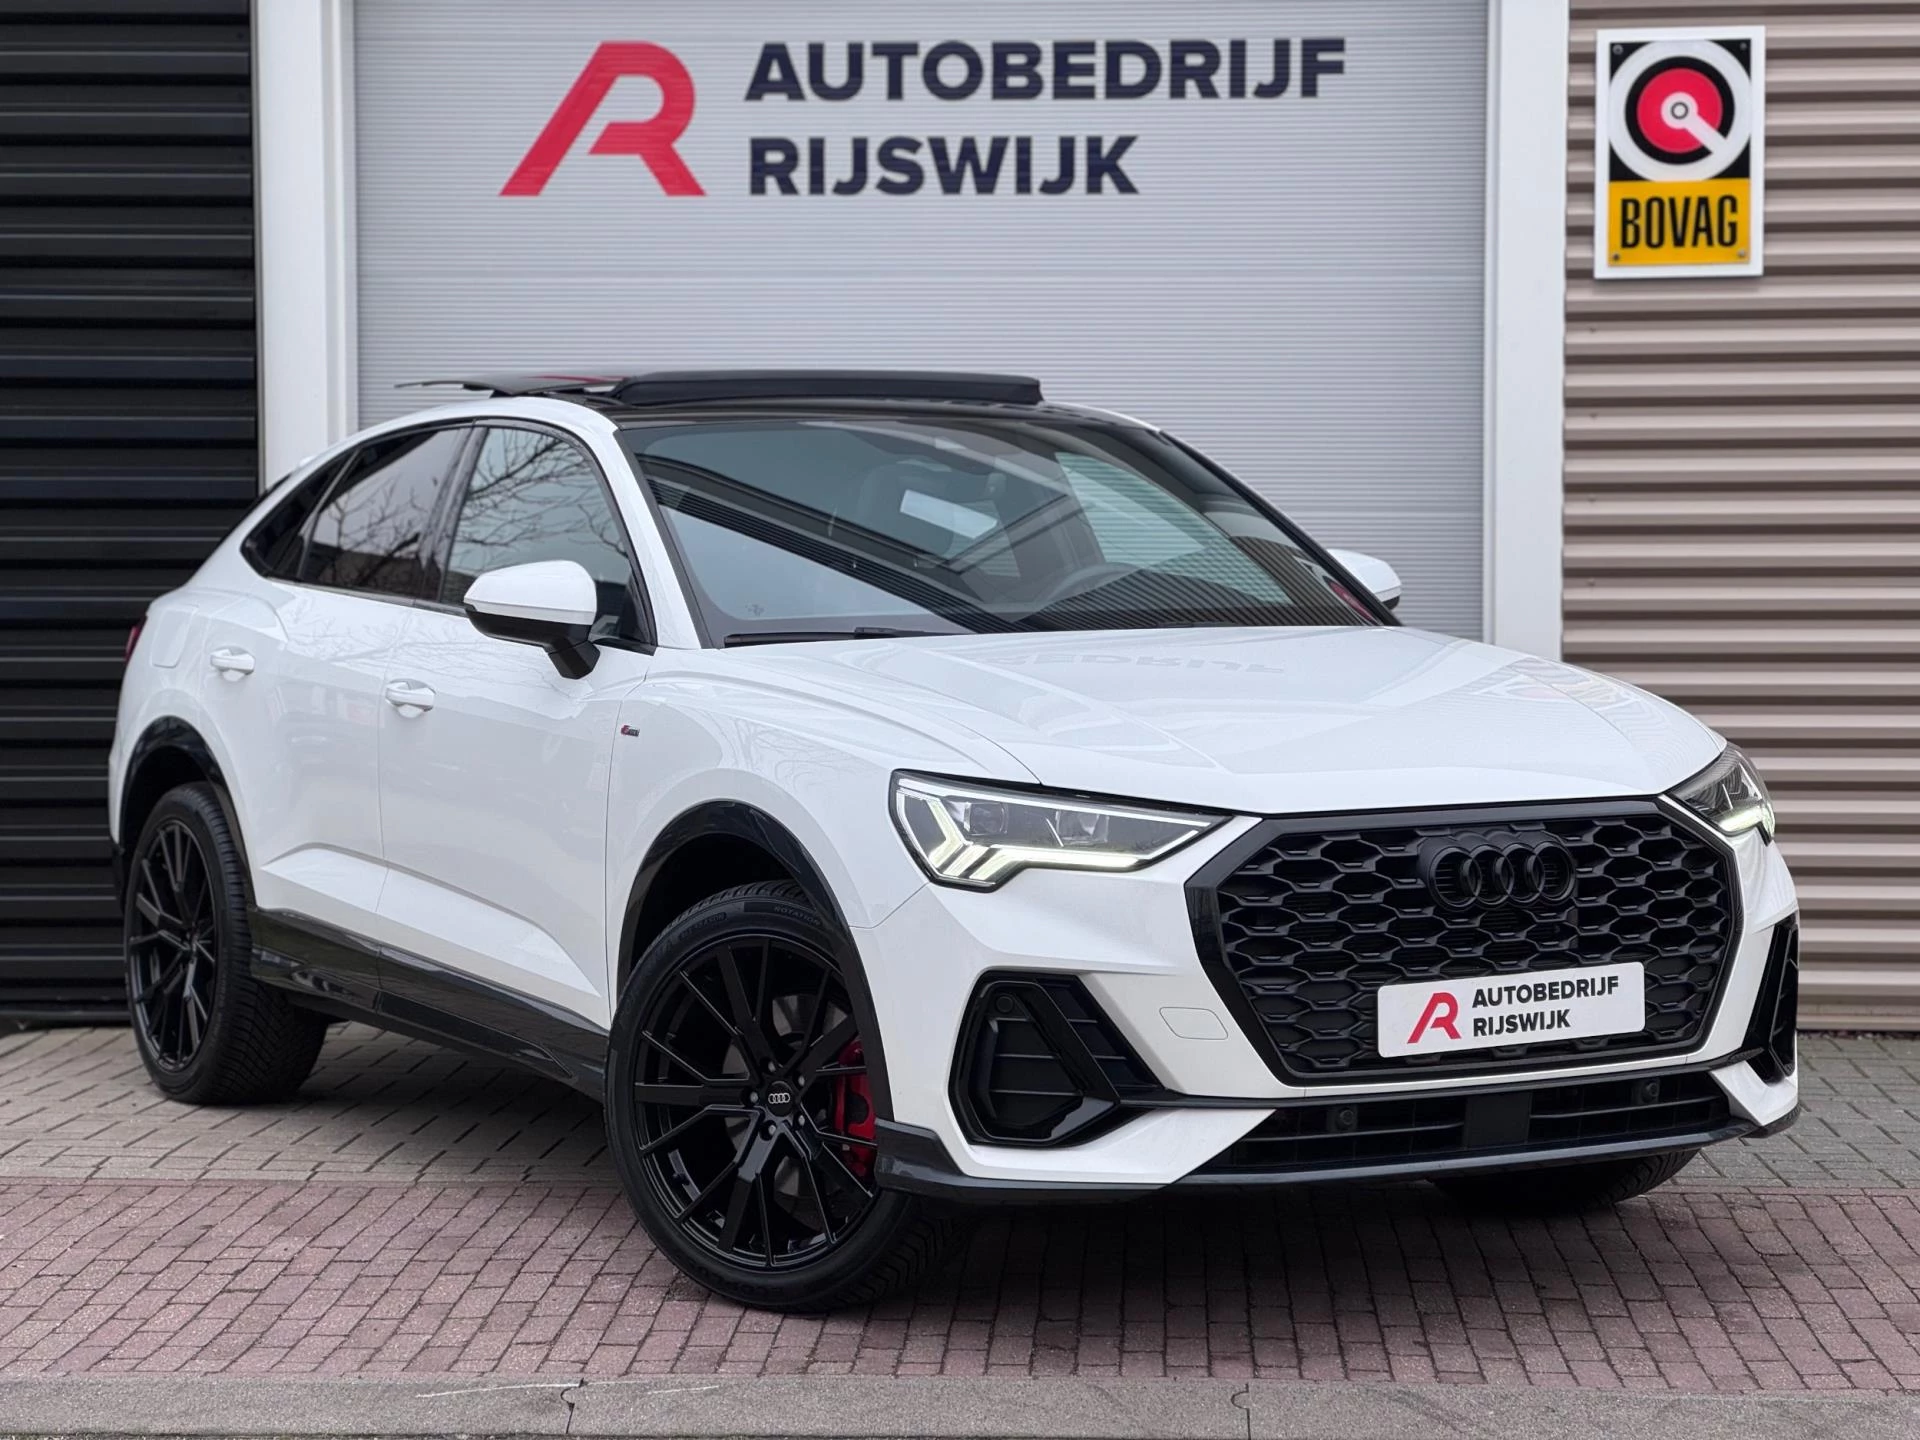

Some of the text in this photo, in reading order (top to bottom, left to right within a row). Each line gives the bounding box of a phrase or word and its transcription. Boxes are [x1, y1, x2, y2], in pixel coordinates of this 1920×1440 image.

[745, 38, 1346, 102] AUTOBEDRIJF
[749, 136, 1139, 196] RIJSWIJK
[1620, 195, 1738, 249] BOVAG
[1472, 976, 1619, 1008] AUTOBEDRIJF
[1473, 1009, 1571, 1037] RIJSWIJK
